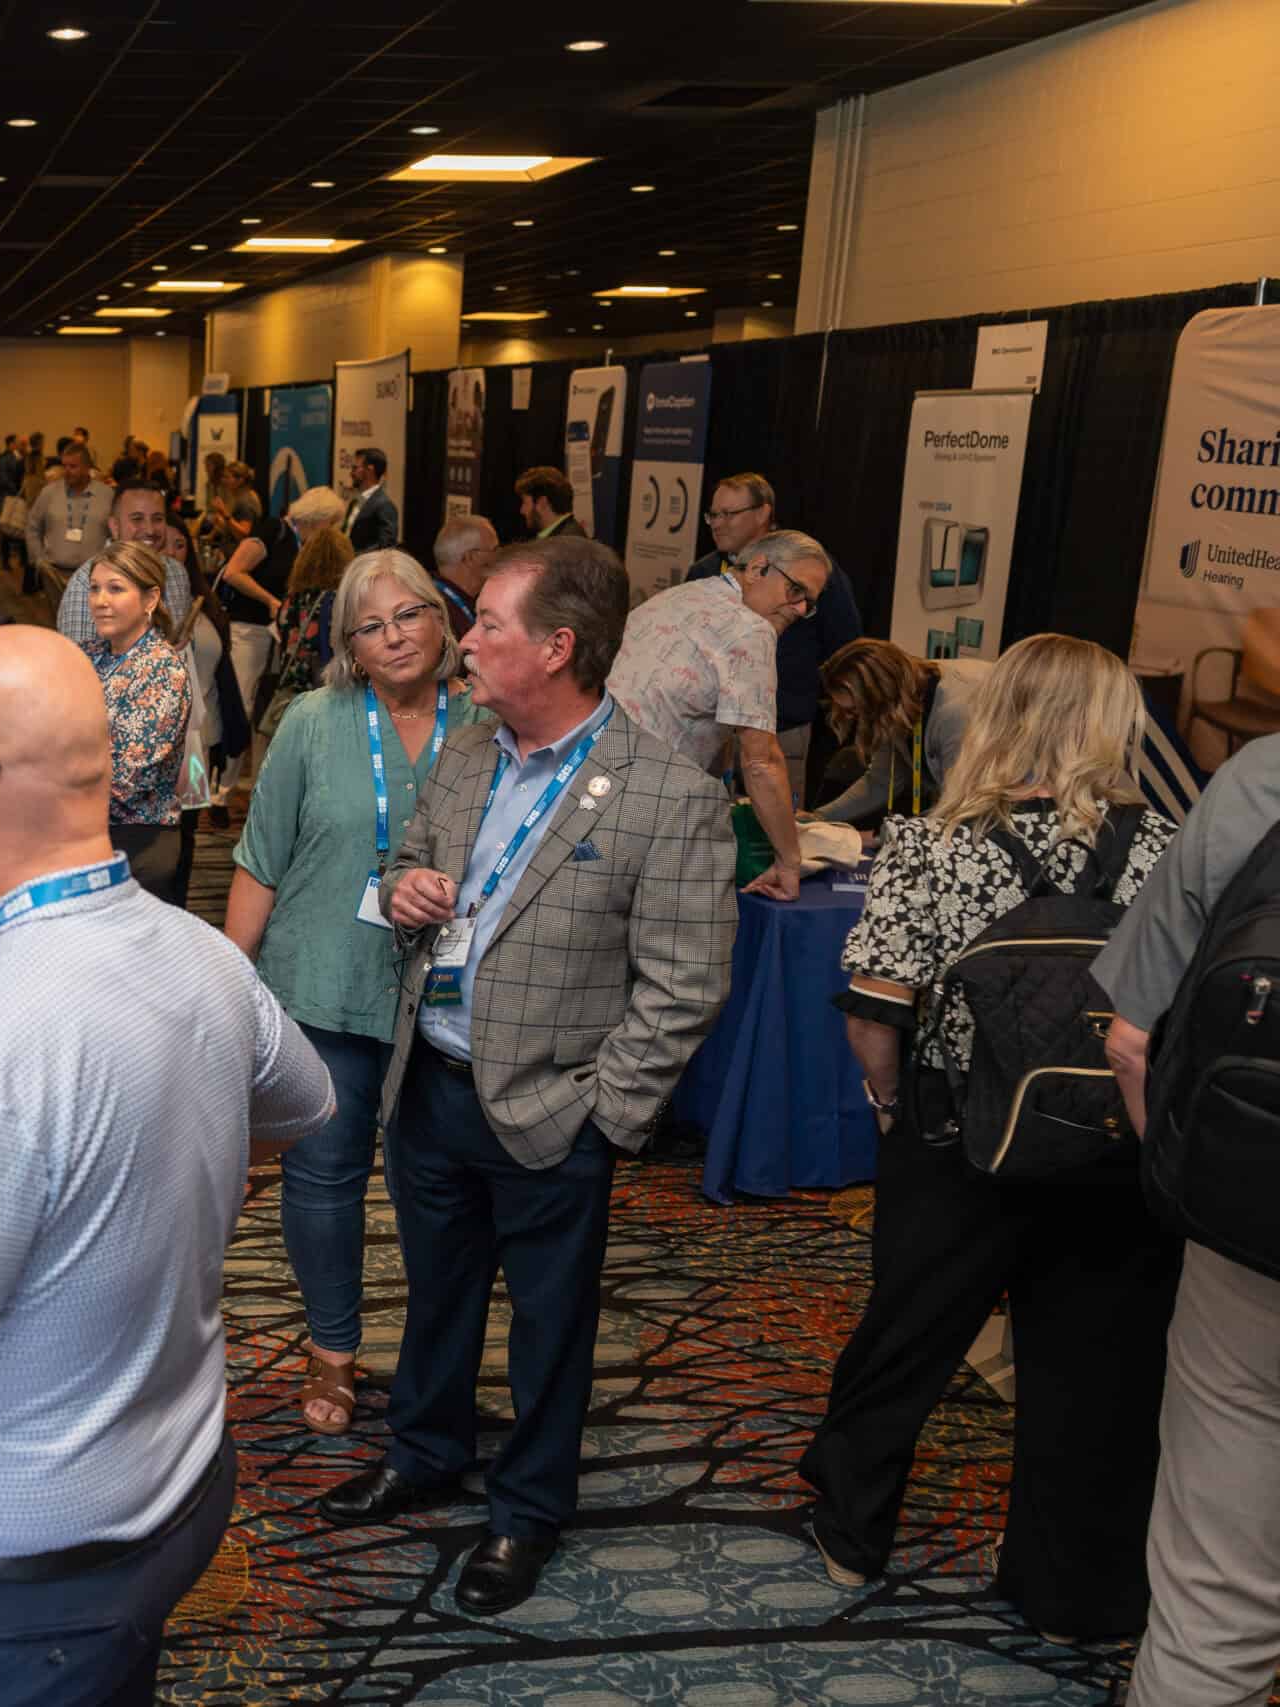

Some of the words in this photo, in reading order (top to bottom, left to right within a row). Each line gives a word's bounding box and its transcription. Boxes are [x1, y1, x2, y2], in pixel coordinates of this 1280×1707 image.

[923, 430, 1009, 449] PerfectDome
[1197, 427, 1280, 467] Shari
[1202, 568, 1245, 590] Hearing
